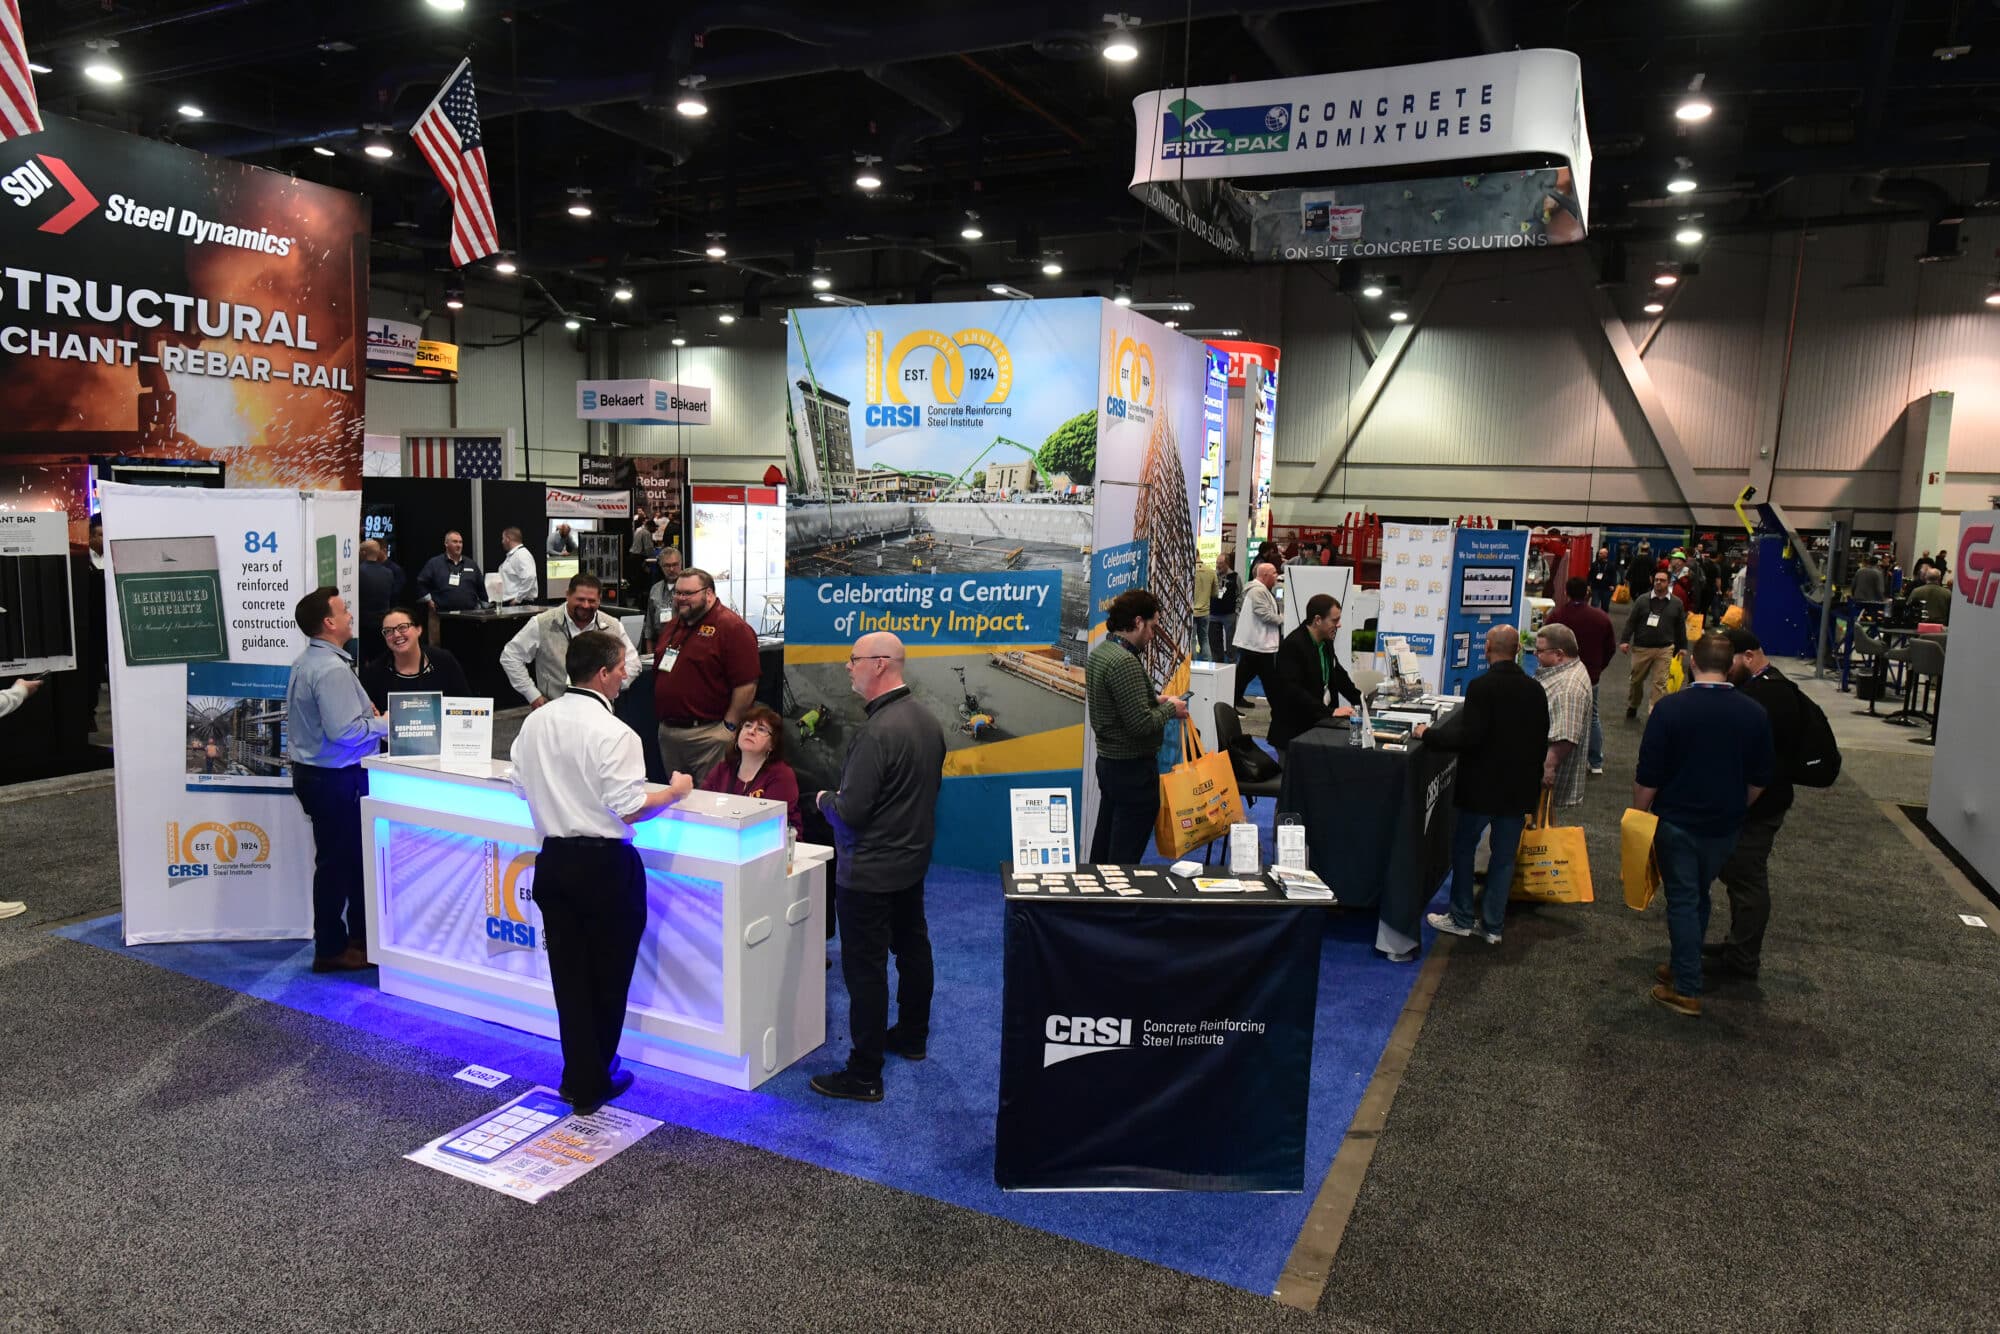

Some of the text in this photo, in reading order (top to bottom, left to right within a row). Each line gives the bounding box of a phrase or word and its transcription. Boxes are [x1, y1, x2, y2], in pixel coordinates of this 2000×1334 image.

[1299, 83, 1493, 123] CONCRETE
[1296, 113, 1493, 150] ADMIXTURES
[1, 160, 53, 207] SDI
[105, 194, 291, 257] Steel Dynamics
[1187, 209, 1207, 240] YOUR
[1208, 225, 1233, 254] SLUMP
[1284, 232, 1549, 260] ON-SITE CONCRETE SOLUTIONS
[0, 267, 318, 351] TRUCTURAL
[929, 334, 955, 356] YEAR
[904, 368, 994, 381] EST. 1924
[600, 393, 644, 407] Bekaert
[670, 397, 707, 412] Bekaert
[1106, 395, 1127, 418] CRSI
[865, 405, 920, 427] CRSI
[927, 405, 1012, 417] Concrete Reinforcing
[927, 417, 984, 427] Steel Institute
[582, 474, 609, 486] Fiber
[636, 476, 670, 487] Rebar
[647, 490, 666, 499] out
[365, 515, 393, 532] 98%
[244, 531, 278, 553] 84
[242, 560, 283, 575] years of
[1102, 549, 1137, 569] Celebrating
[237, 578, 289, 591] reinforced
[1107, 569, 1132, 588] Century
[133, 589, 208, 604] REINFORCED
[817, 580, 1050, 608] Celebrating a Century
[143, 603, 202, 616] CONCRETE
[242, 600, 285, 610] concrete
[232, 616, 296, 629] construction
[834, 611, 1030, 637] of Industry Impact.
[242, 635, 288, 651] guidance.
[168, 864, 208, 877] CRSI
[486, 917, 536, 948] CRSI
[1045, 1014, 1132, 1046] CRSI
[1143, 1018, 1265, 1035] Concrete Reinforcing
[1142, 1033, 1224, 1046] Steel Institute
[565, 1122, 600, 1137] FREE!
[549, 1130, 585, 1147] Rebar
[533, 1139, 596, 1164] Reference
